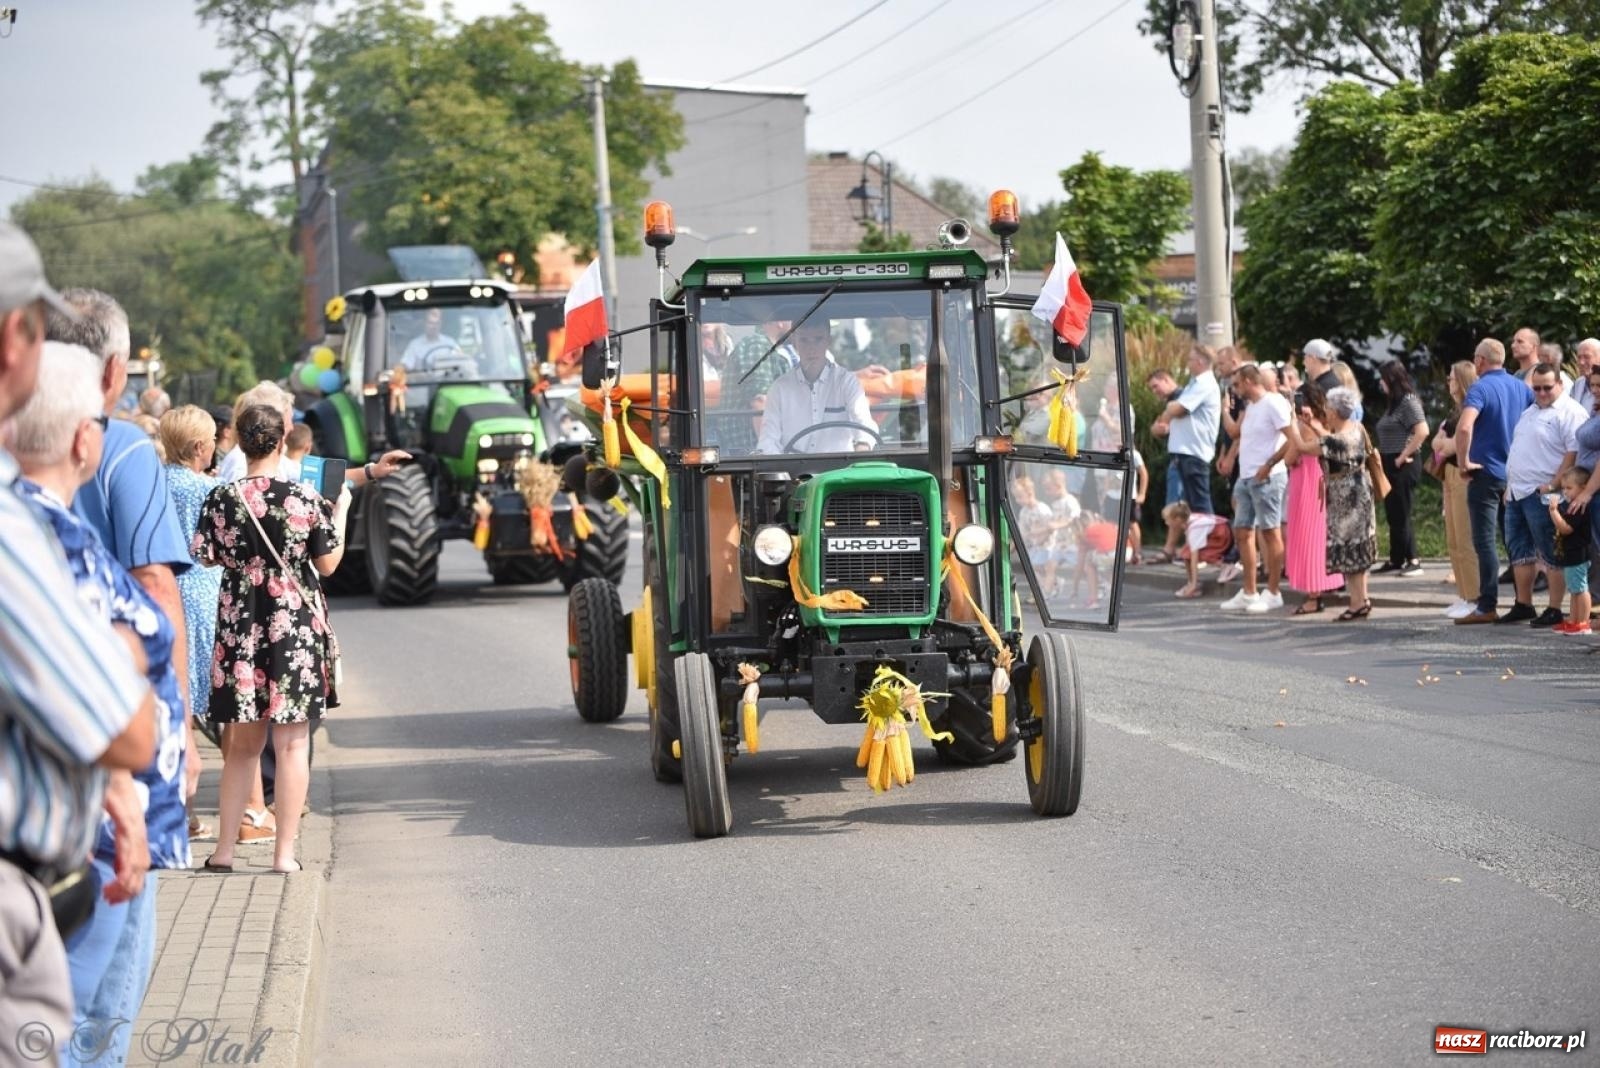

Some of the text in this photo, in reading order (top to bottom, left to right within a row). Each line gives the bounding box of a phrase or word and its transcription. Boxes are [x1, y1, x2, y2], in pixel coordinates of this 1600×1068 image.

[772, 263, 908, 277] URSUS C-330
[831, 539, 917, 551] URSUS
